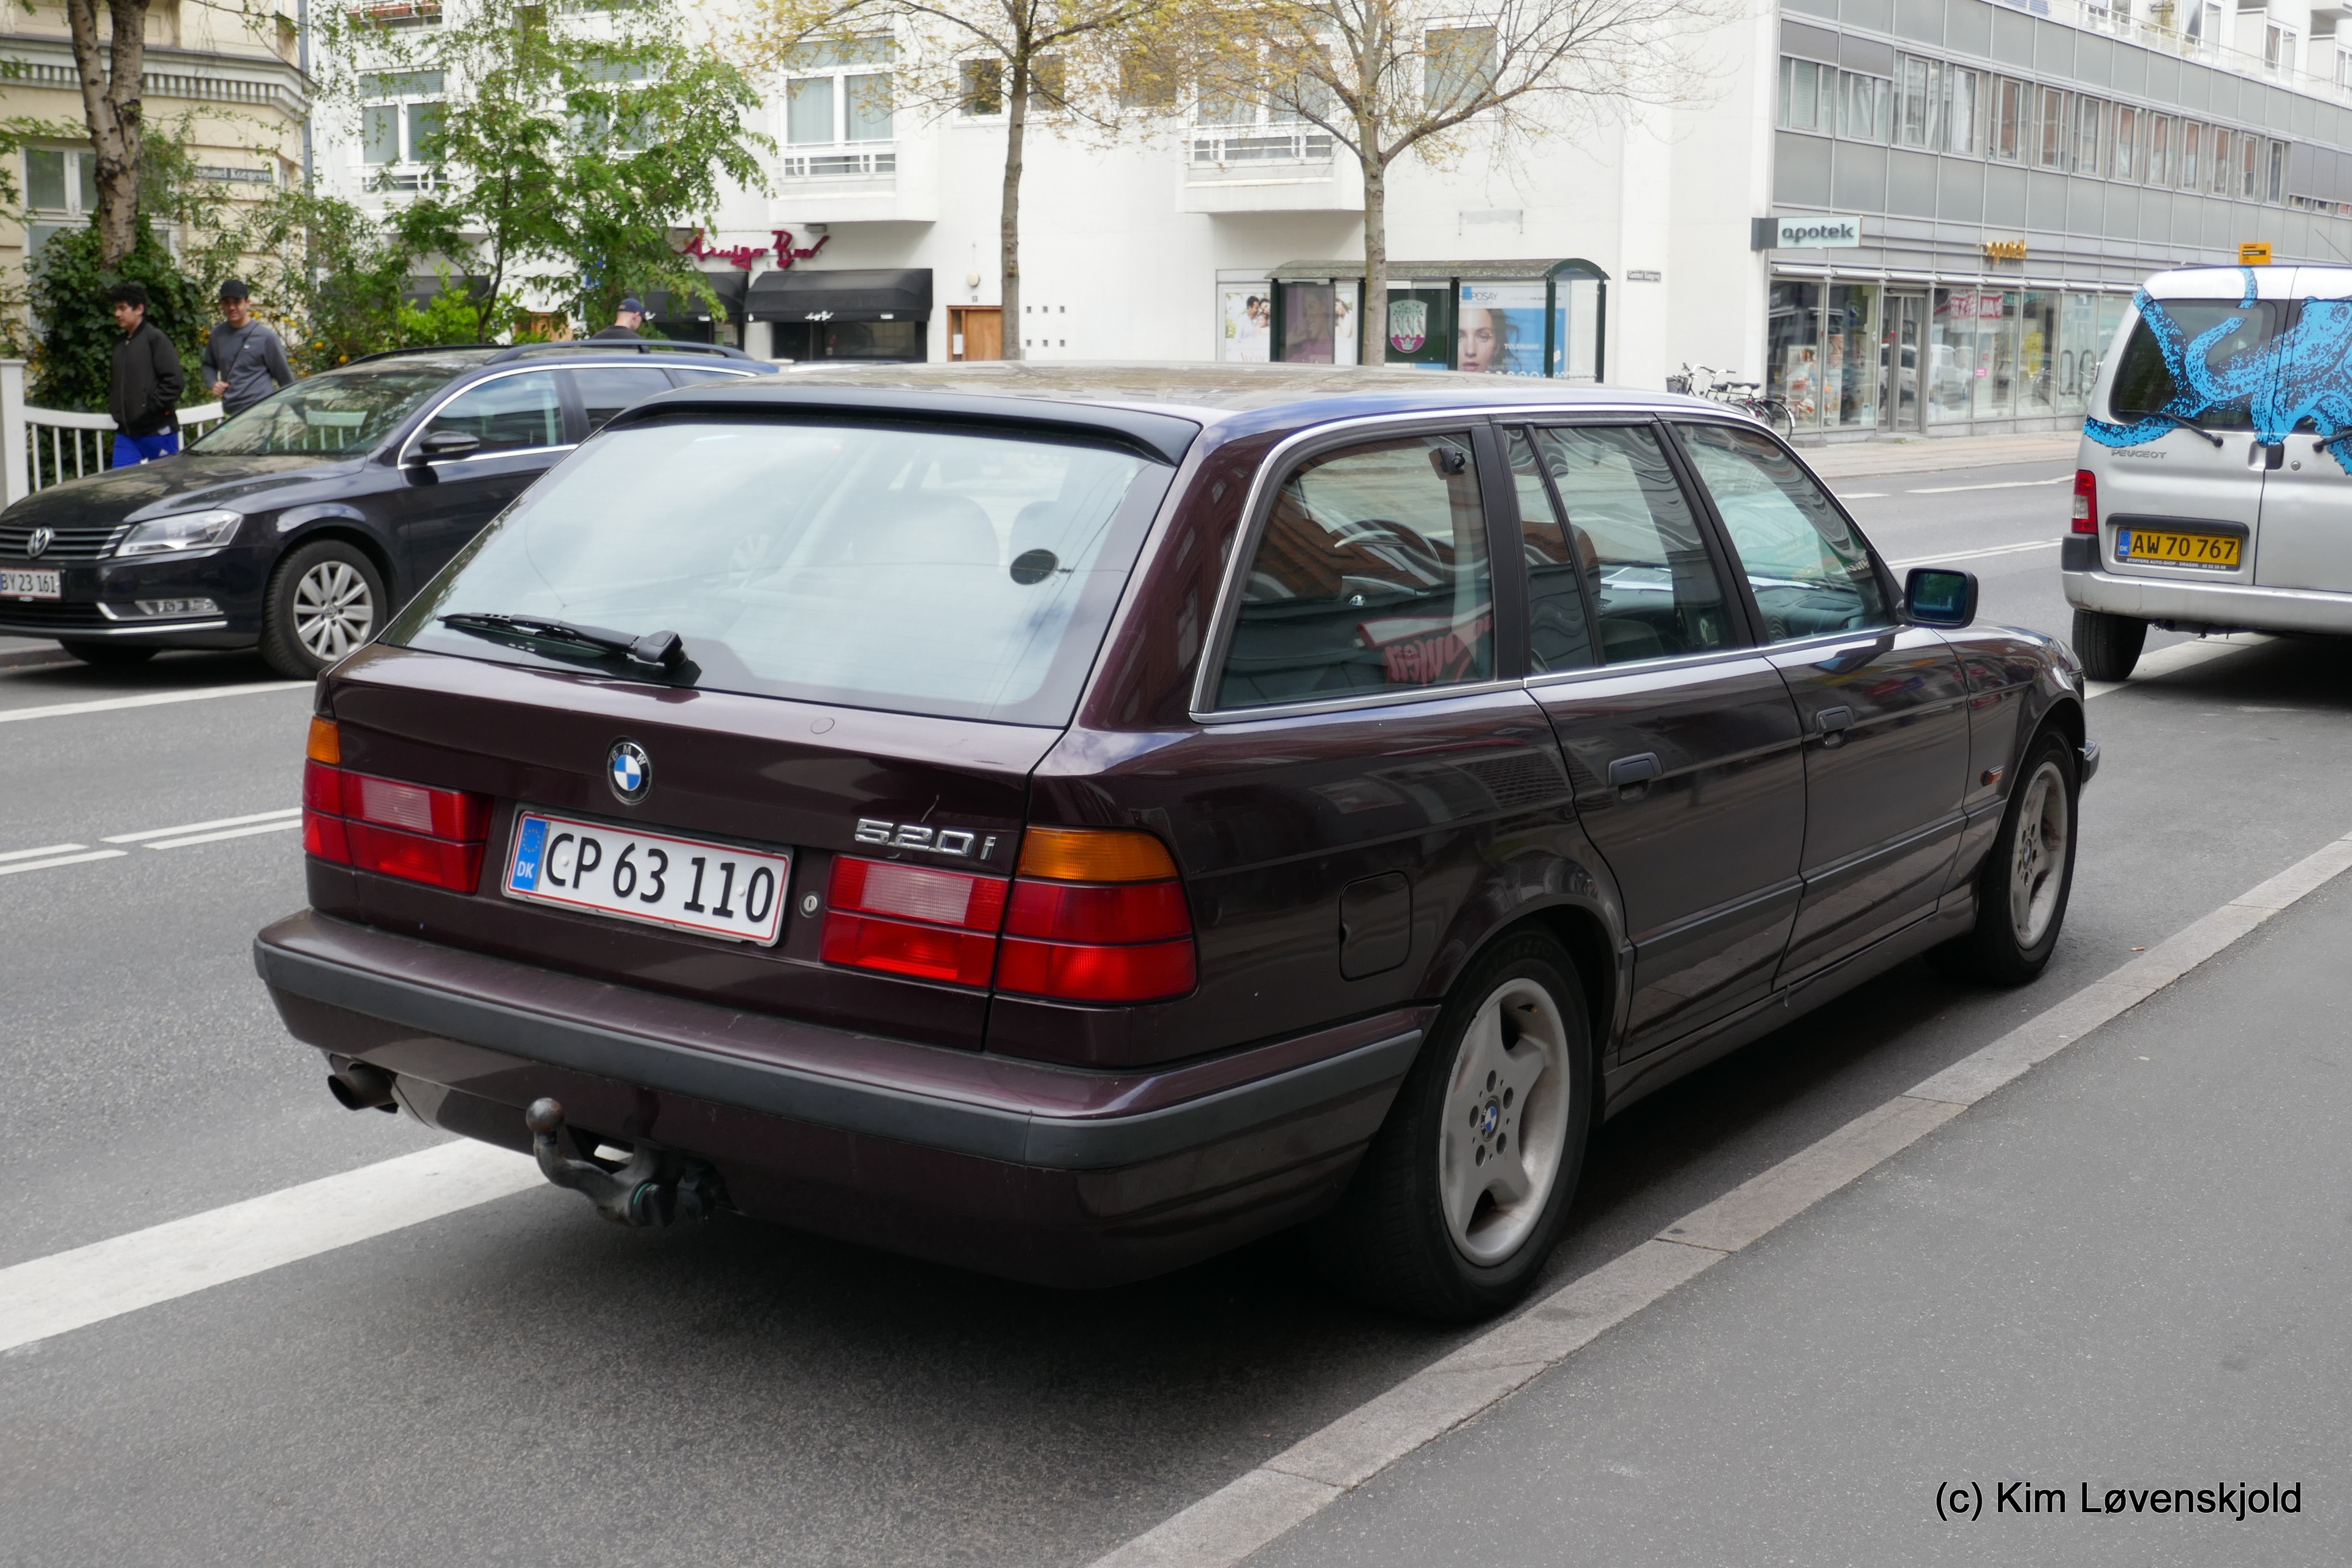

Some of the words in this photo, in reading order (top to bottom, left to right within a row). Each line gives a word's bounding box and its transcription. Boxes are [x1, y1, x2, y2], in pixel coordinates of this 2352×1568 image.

[1782, 224, 1854, 243] apotek
[1472, 292, 1498, 301] POSAY
[2111, 449, 2166, 458] PEUGEOT
[2132, 535, 2160, 554] AW
[2166, 537, 2190, 556] 70
[2197, 539, 2236, 559] 767
[2, 574, 15, 590] BY
[19, 575, 33, 591] 23
[37, 576, 56, 592] 161
[611, 744, 647, 766] BMW
[854, 818, 997, 861] 520i
[516, 861, 535, 880] DK
[546, 833, 602, 889] CP
[613, 842, 669, 903] 63
[684, 856, 774, 923] 110
